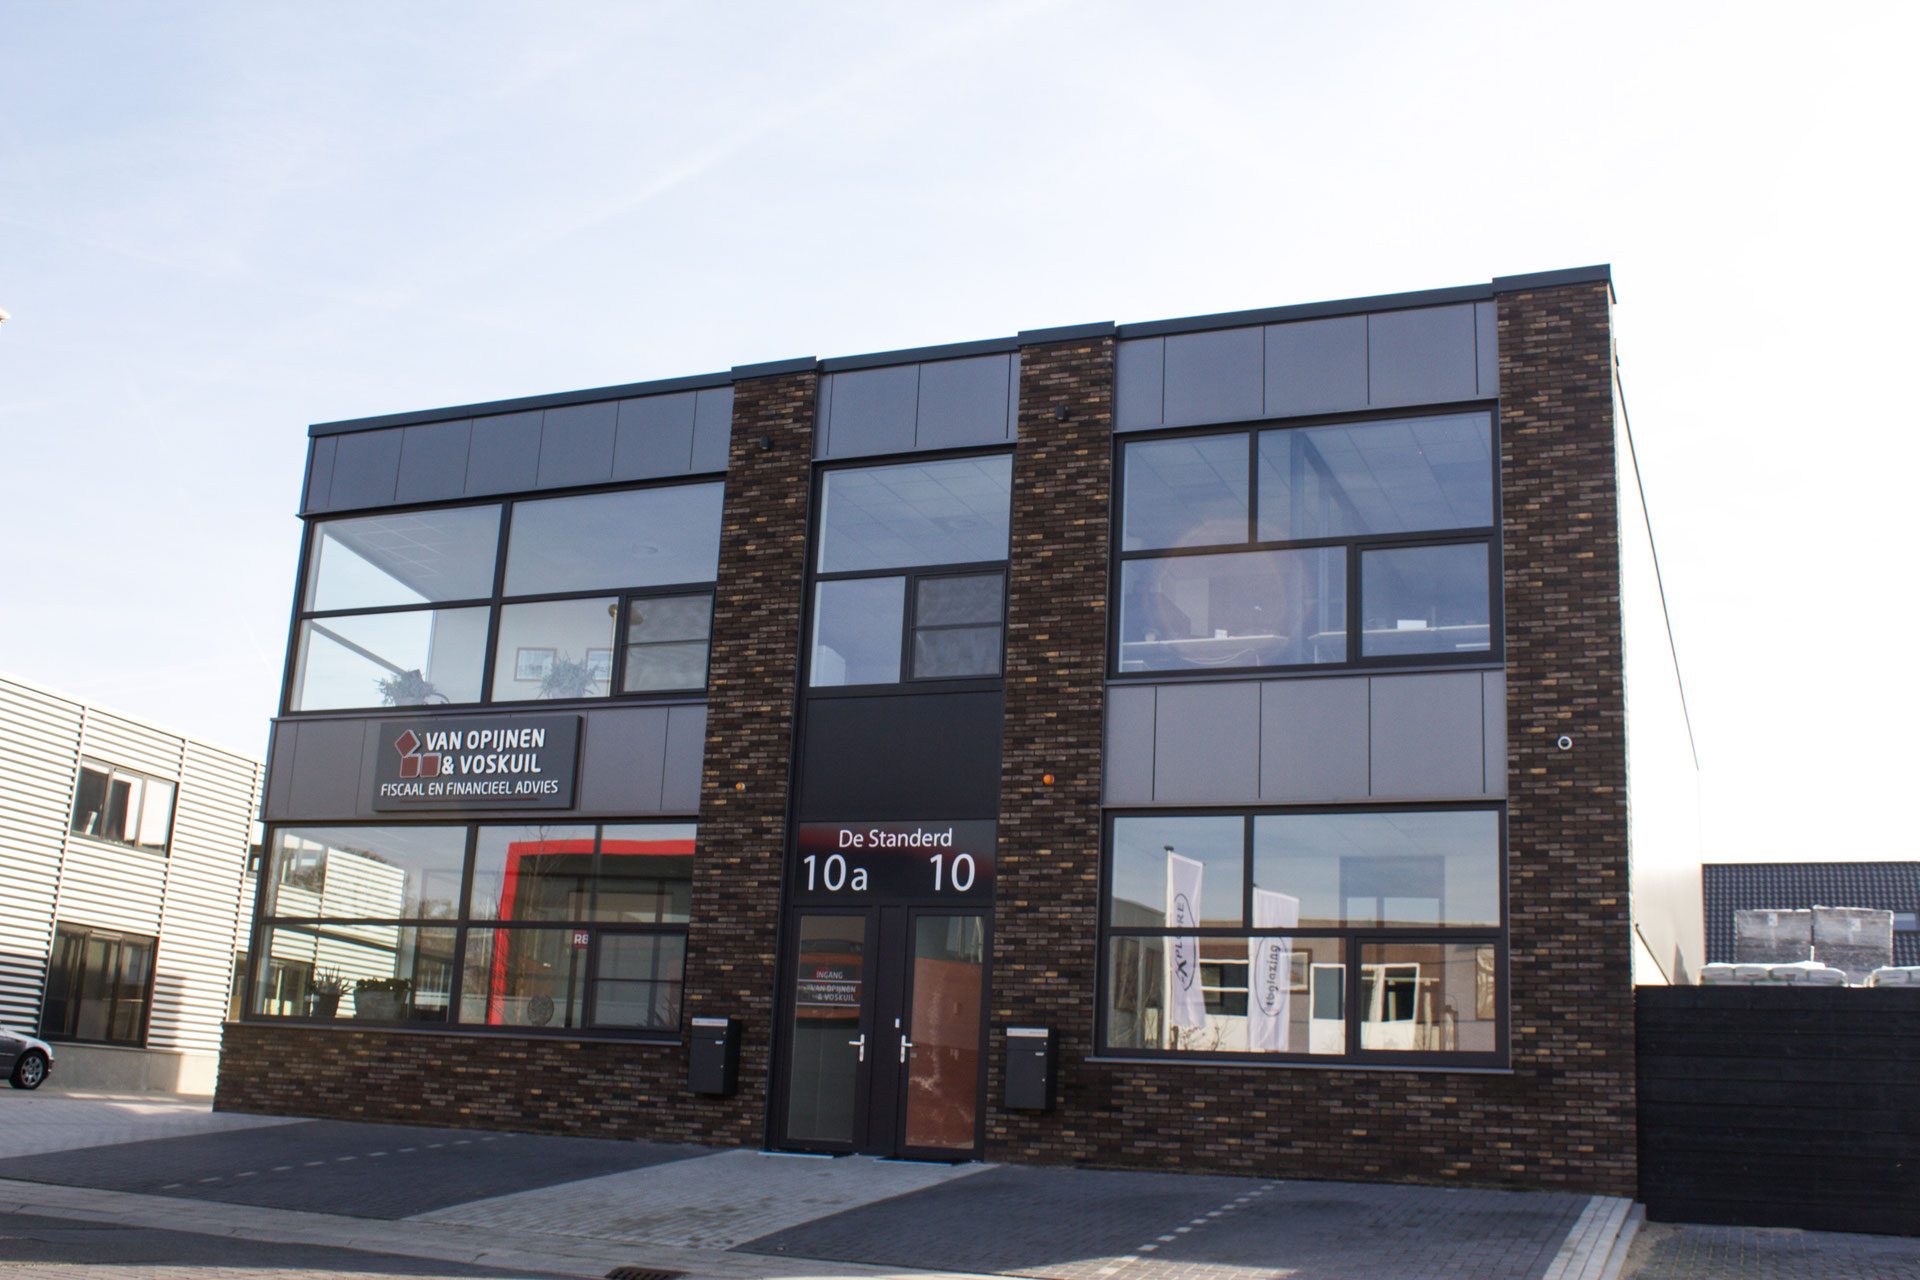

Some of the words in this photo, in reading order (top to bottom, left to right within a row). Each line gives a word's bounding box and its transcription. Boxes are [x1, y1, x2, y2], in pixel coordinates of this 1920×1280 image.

[426, 731, 462, 751] VAN
[466, 728, 546, 752] OPIJNEN
[441, 755, 454, 775] &
[460, 753, 542, 774] VOSKUIL
[380, 783, 425, 796] FISCAAL
[428, 782, 443, 795] EN
[445, 781, 512, 795] FINANCIEEL
[514, 780, 559, 794] ADVIES
[839, 829, 864, 848] De
[868, 827, 953, 848] Standerd
[803, 853, 868, 892] 10a
[930, 853, 976, 892] 10
[816, 970, 844, 980] INGANG
